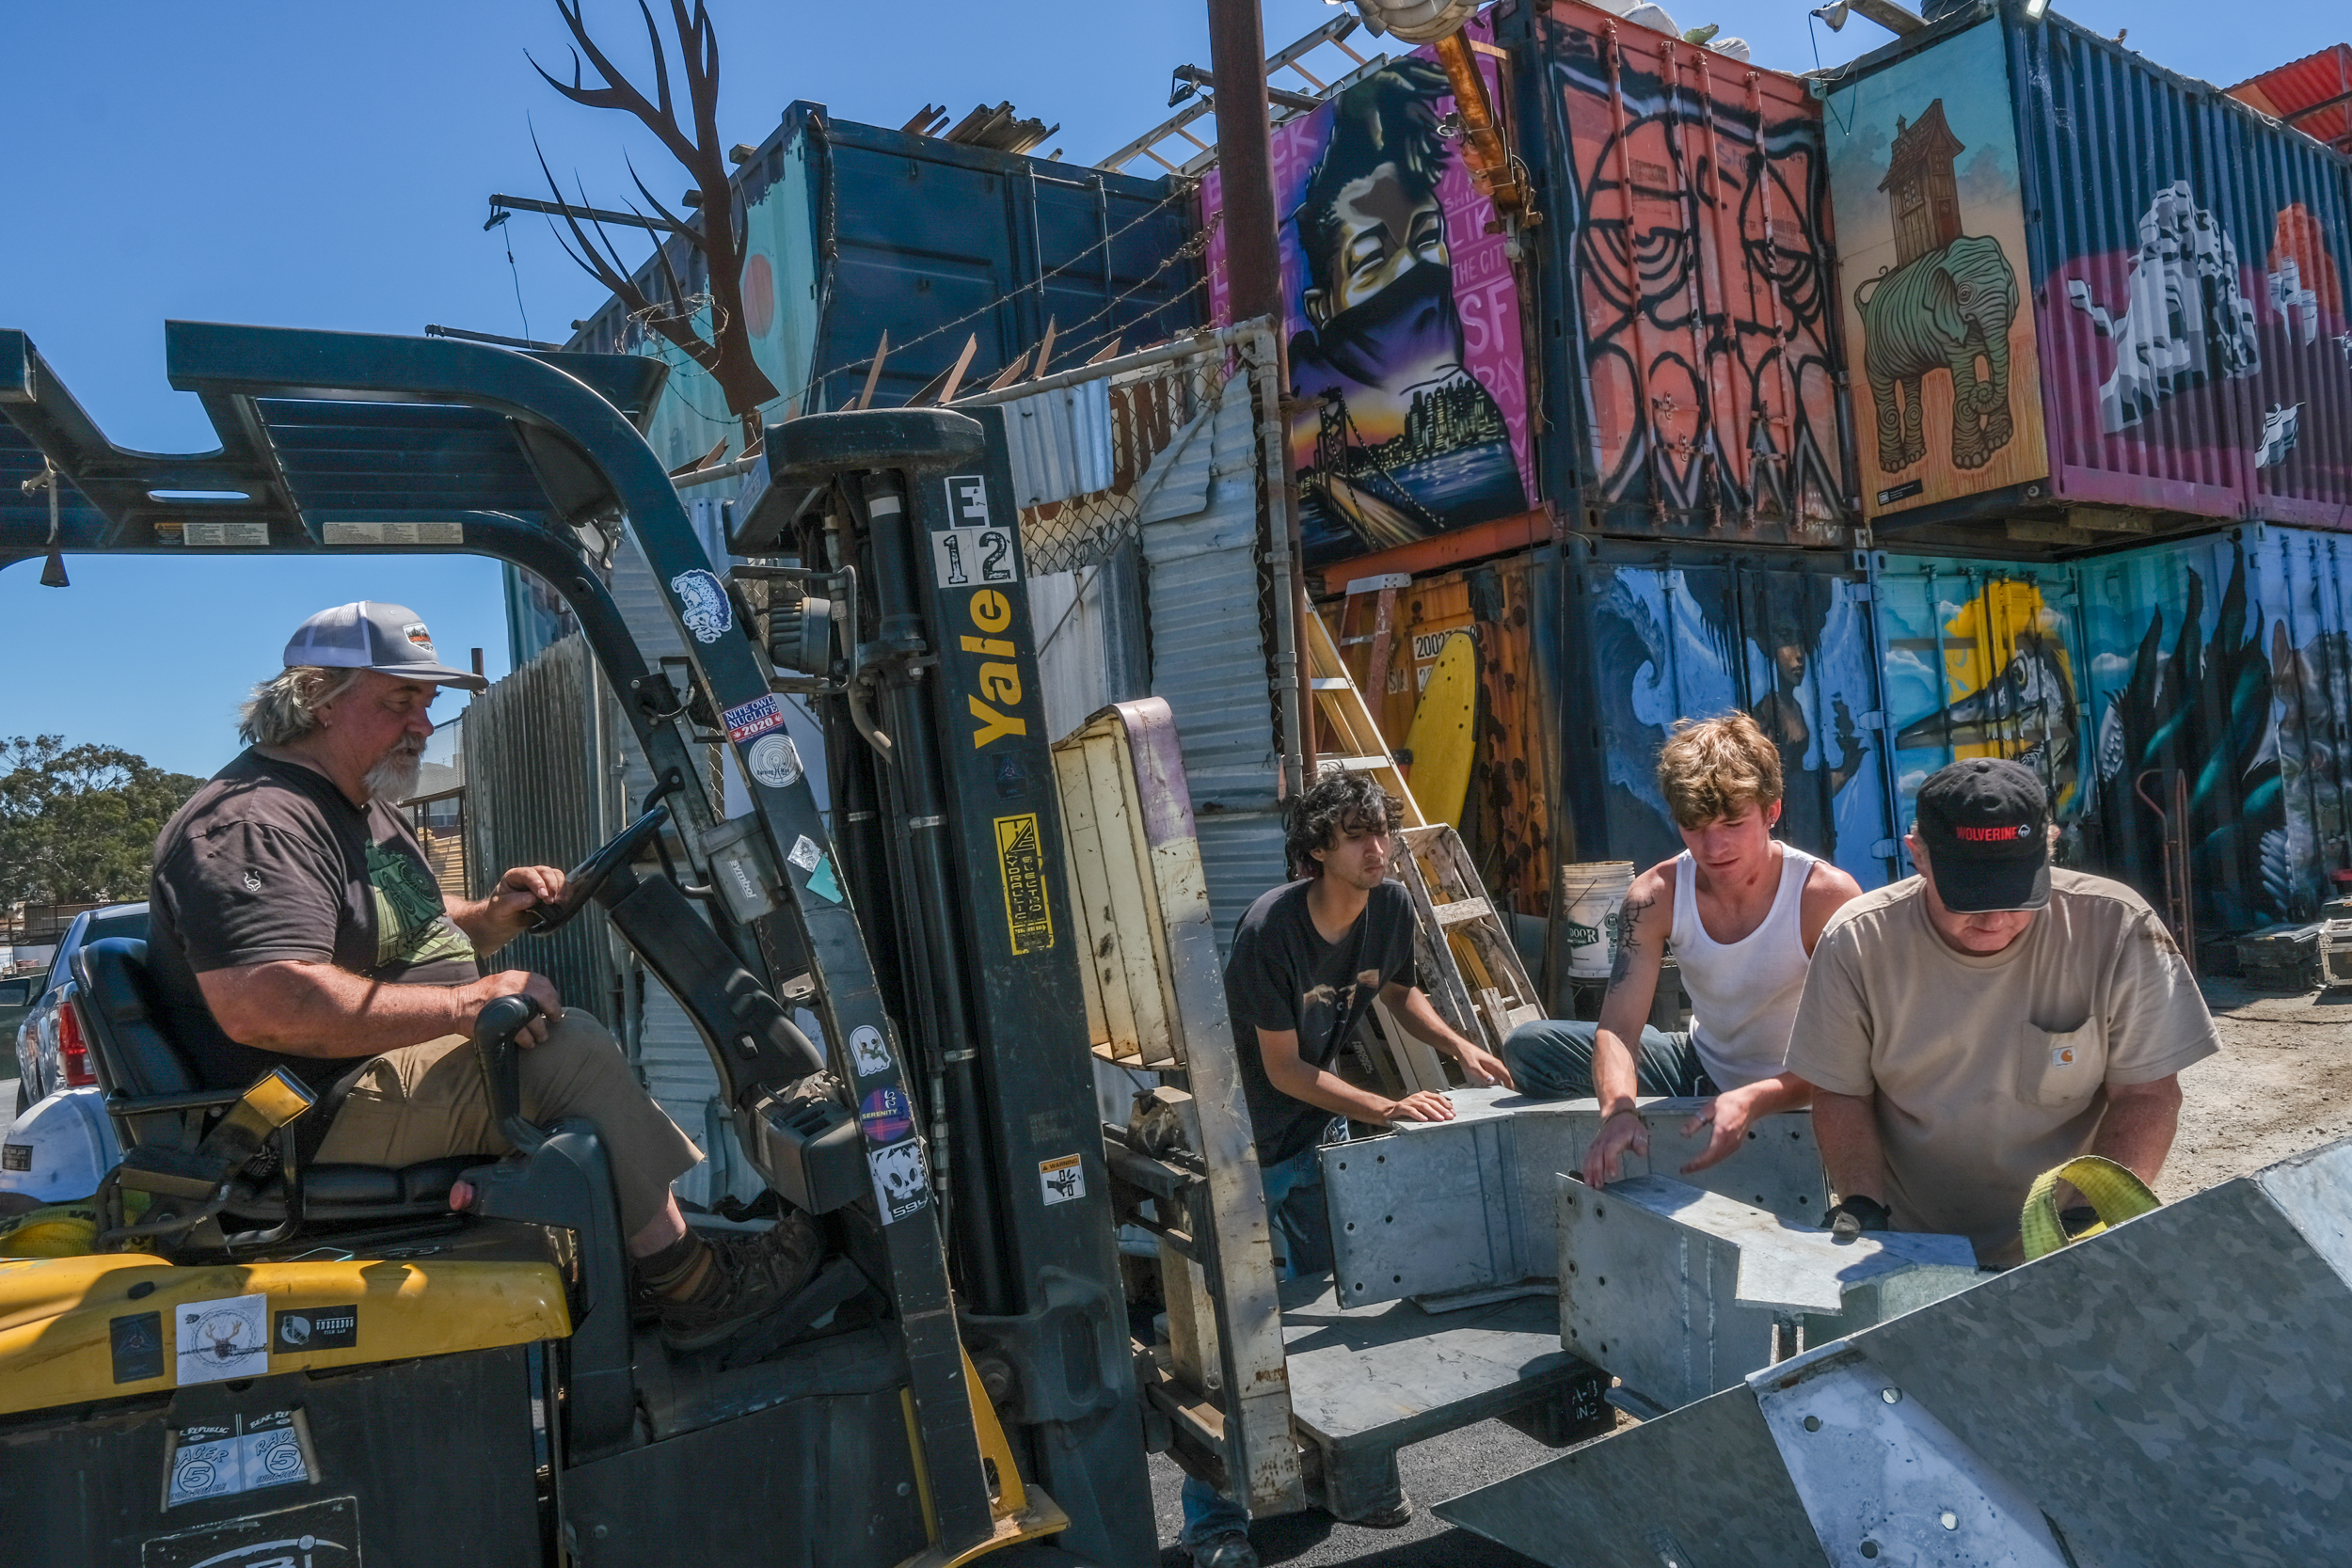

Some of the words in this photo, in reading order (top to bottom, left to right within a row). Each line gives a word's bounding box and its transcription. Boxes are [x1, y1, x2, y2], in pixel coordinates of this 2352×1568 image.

[1448, 202, 1491, 249] LIK
[1451, 256, 1478, 287] THE
[1480, 242, 1506, 275] CIT
[1459, 277, 1515, 356] SF
[948, 477, 986, 529] E
[943, 531, 1010, 584] 12
[960, 589, 1026, 749] Yale
[725, 705, 751, 721] NITE
[752, 696, 774, 710] OWL
[727, 704, 778, 729] NUGLIFE
[741, 717, 774, 736] 2020
[1956, 826, 2019, 841] WOLVERINE
[732, 860, 757, 898] symbol
[862, 1108, 898, 1119] SERENITY
[1050, 1158, 1078, 1169] WARNING
[316, 1318, 354, 1331] UNDERDOG
[188, 1426, 230, 1435] REPUBLIC
[249, 1413, 273, 1430] BEAR
[269, 1449, 297, 1471] 5
[183, 1467, 211, 1488] 5
